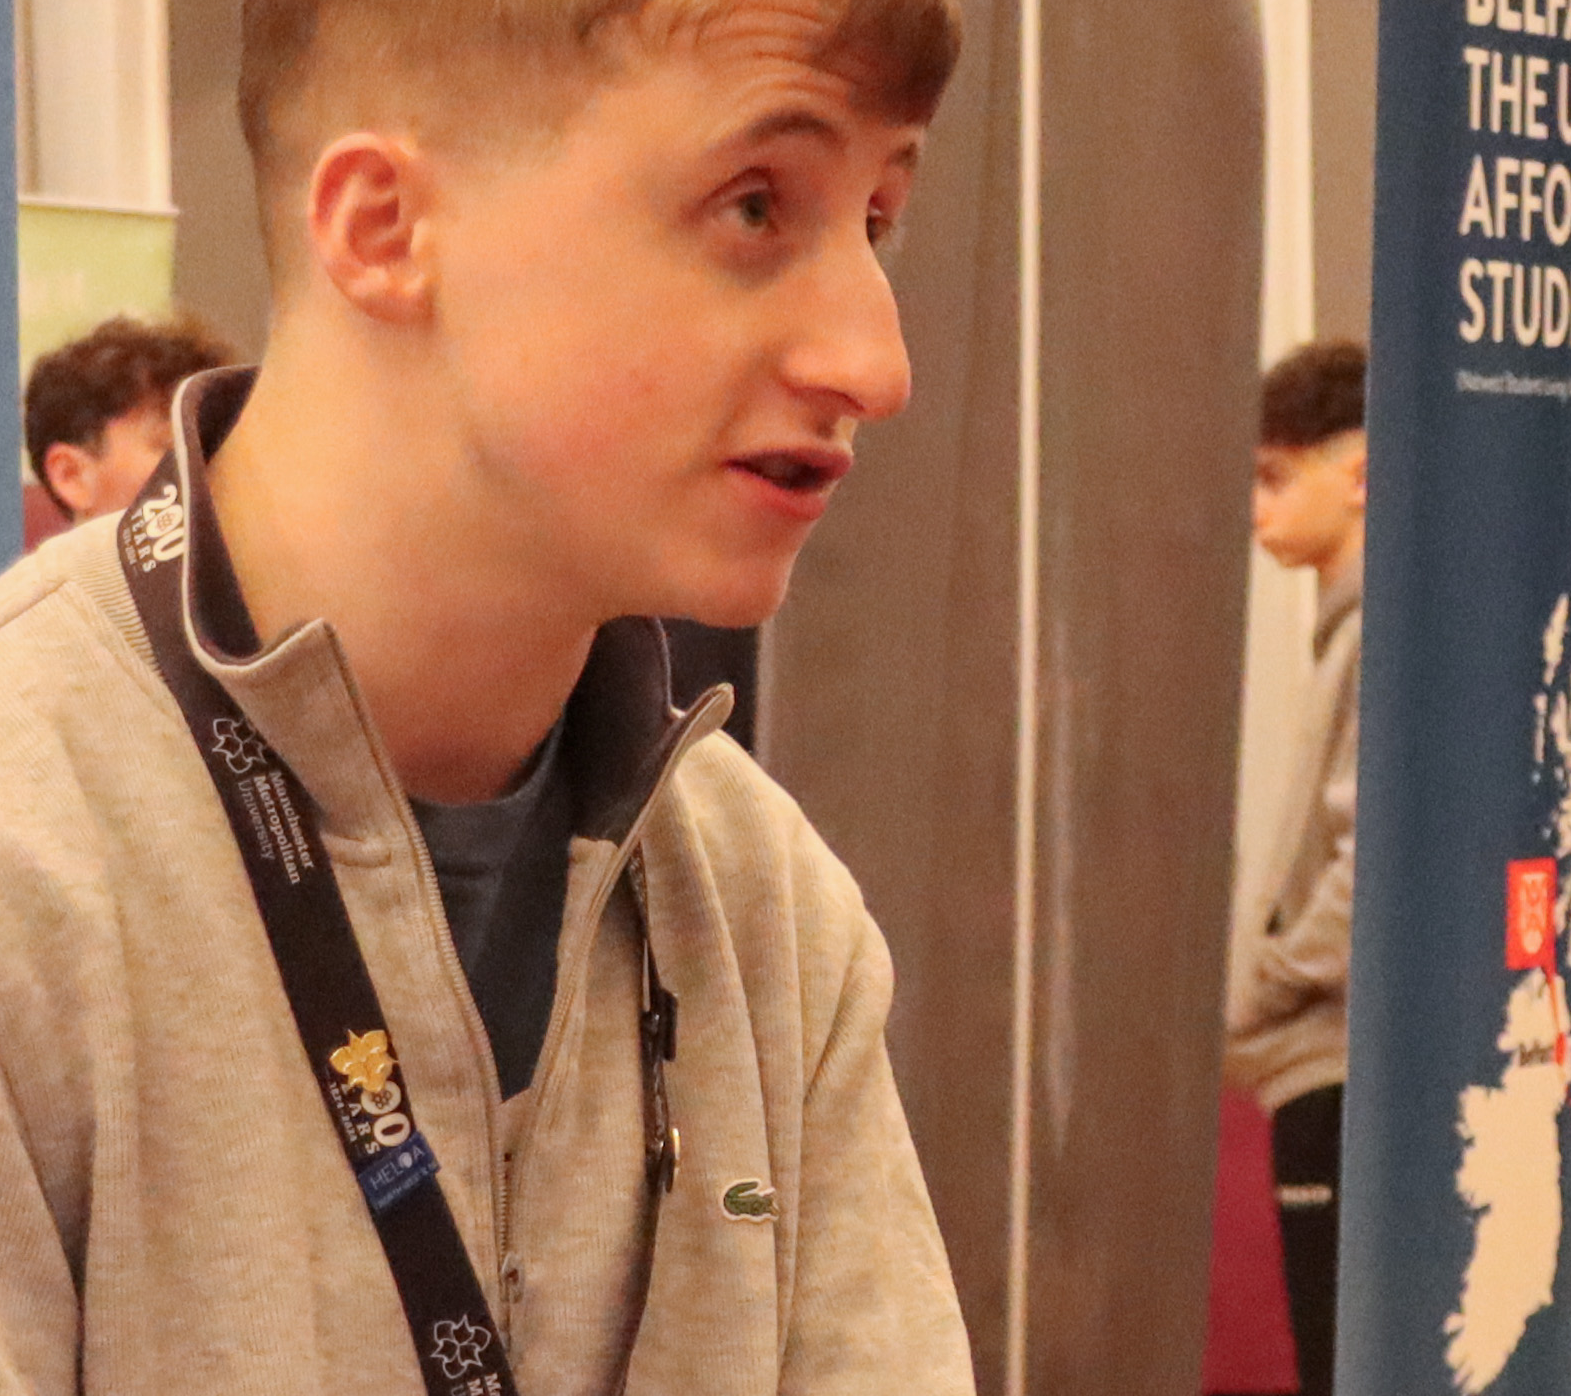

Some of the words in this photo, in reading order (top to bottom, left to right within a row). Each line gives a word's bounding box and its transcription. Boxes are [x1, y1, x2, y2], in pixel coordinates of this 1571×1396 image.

[1464, 47, 1549, 139] THE
[237, 780, 276, 860] University
[254, 775, 301, 884] Metropolitan
[270, 770, 315, 868] Manchester
[361, 1080, 411, 1147] 00
